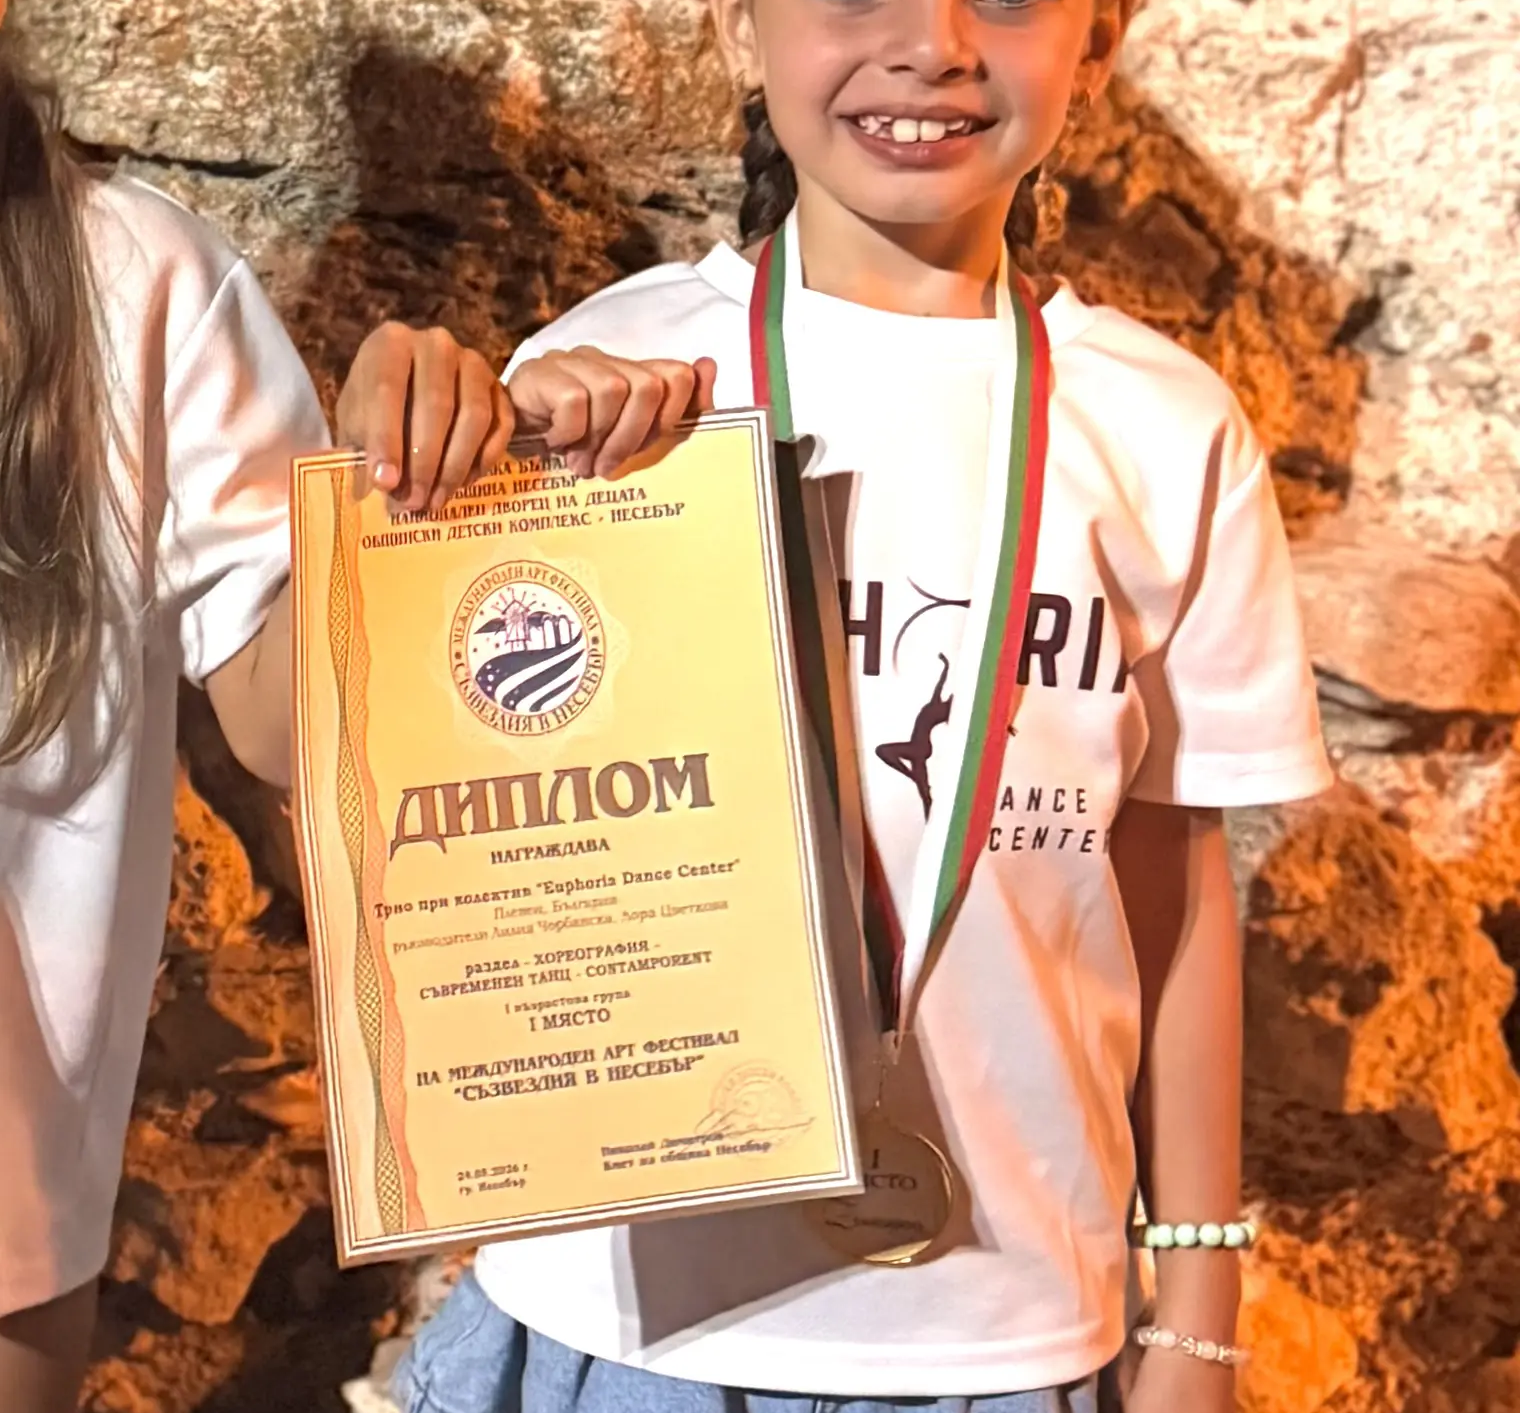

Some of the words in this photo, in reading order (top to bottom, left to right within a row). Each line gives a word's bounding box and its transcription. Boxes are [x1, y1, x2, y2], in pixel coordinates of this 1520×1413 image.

[512, 474, 578, 495] НЕСЕБЪР
[491, 495, 551, 517] ДВОРЕЦ
[556, 494, 578, 510] НА
[585, 487, 648, 507] ДЕЦАТА
[446, 521, 503, 543] ДЕТСКИ
[508, 511, 593, 535] КОМПЛЕКС
[610, 502, 687, 525] НЕСЕБЪР
[388, 752, 716, 862] ДИПЛОМ
[999, 785, 1088, 814] ANCE
[490, 837, 611, 865] НАГРАЖДАВА
[373, 900, 414, 922] Трио
[418, 897, 449, 913] при
[454, 886, 532, 907] колектив
[621, 868, 673, 886] Dance
[464, 958, 520, 979] раздел
[533, 939, 650, 967] ХОРЕОГРАФИЯ
[419, 974, 524, 1001] СЪВРЕМЕНЕН
[527, 967, 572, 987] ТАНЦ
[592, 989, 631, 1005] група
[542, 1007, 612, 1031] МЯСТО
[416, 1070, 442, 1087] НА
[447, 1048, 597, 1083] МЕЖДУНАРОДЕН
[602, 1042, 637, 1062] АРТ
[642, 1029, 740, 1055] ФЕСТИВАЛ
[585, 1069, 600, 1086] В
